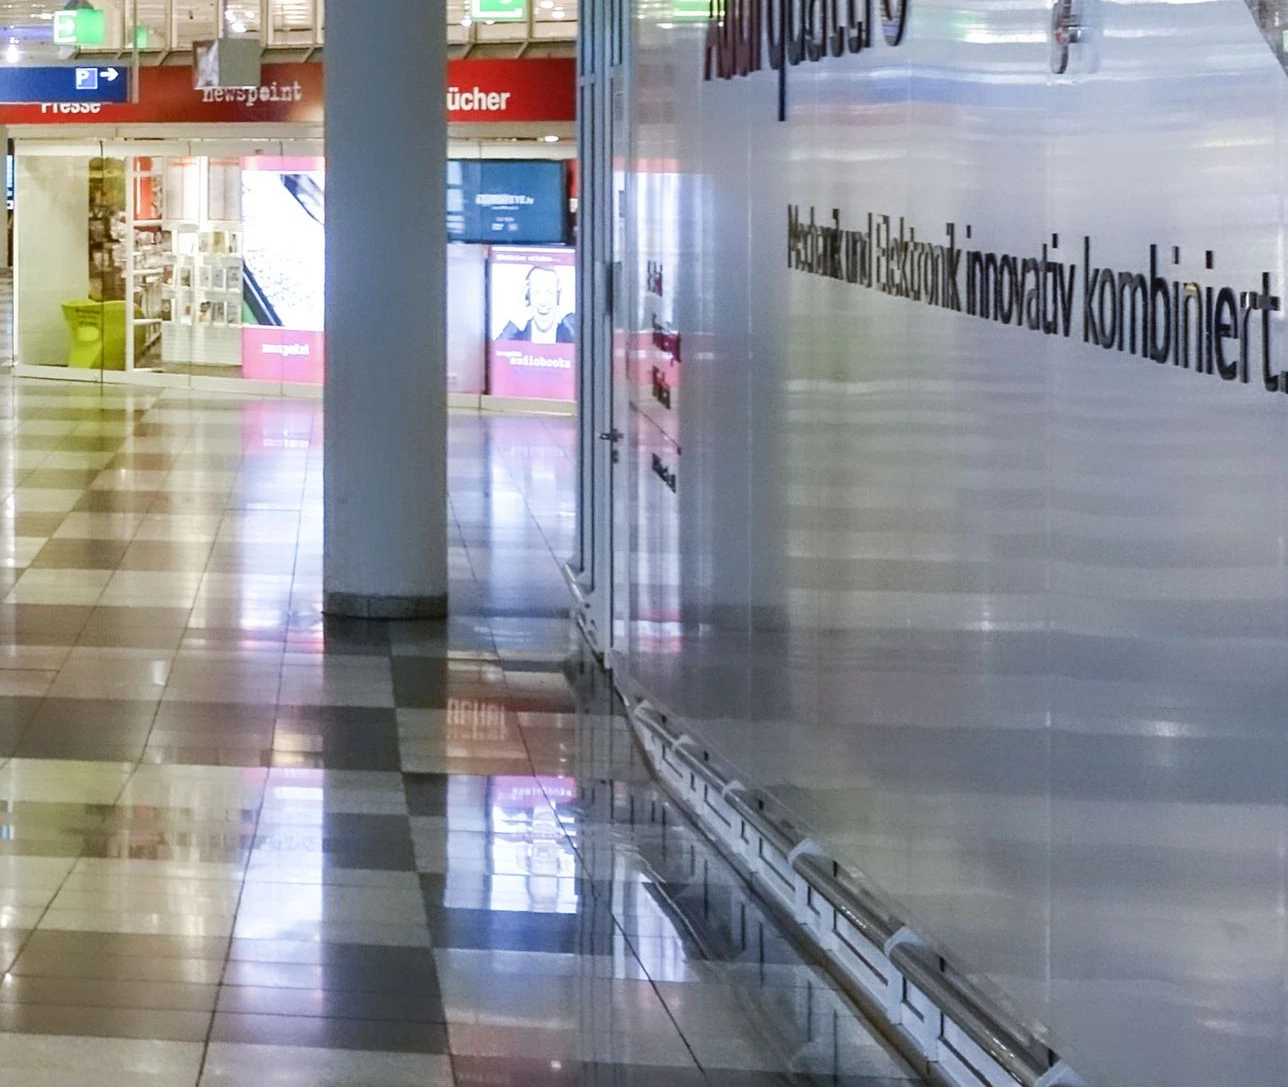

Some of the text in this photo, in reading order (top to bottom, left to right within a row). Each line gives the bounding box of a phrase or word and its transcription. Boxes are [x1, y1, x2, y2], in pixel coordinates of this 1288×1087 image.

[201, 80, 303, 107] newspoint
[447, 86, 511, 111] ücher
[845, 212, 873, 289] und
[875, 214, 963, 312] Elektronik
[966, 225, 1077, 338] innovativ
[1083, 235, 1288, 395] kombiniert.
